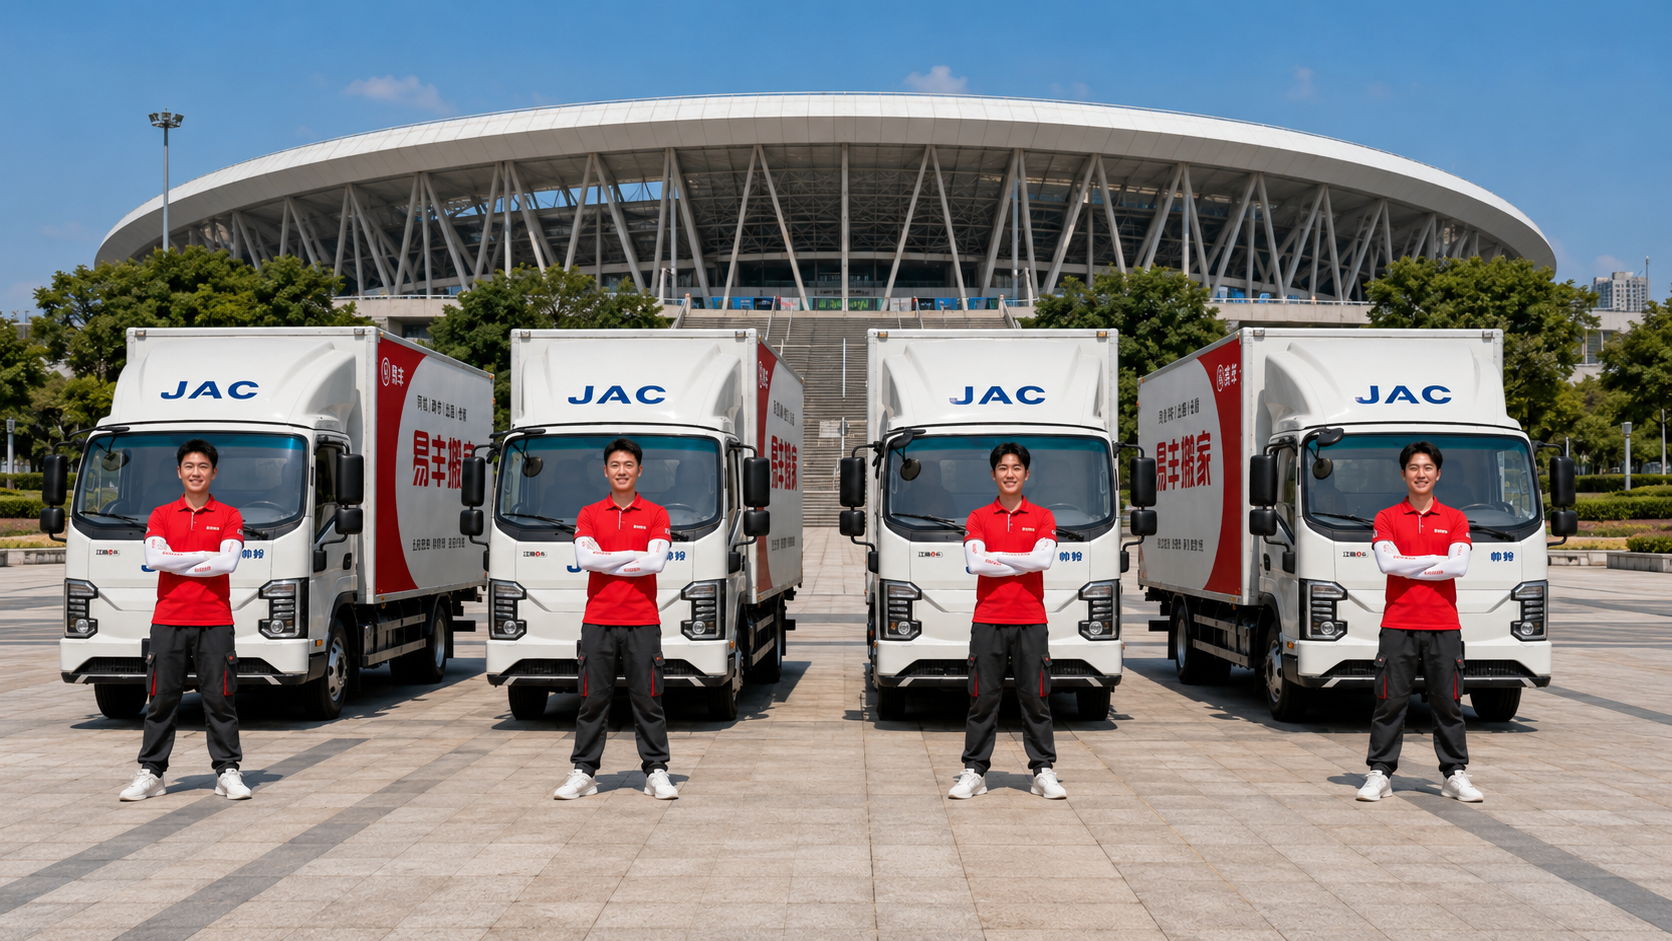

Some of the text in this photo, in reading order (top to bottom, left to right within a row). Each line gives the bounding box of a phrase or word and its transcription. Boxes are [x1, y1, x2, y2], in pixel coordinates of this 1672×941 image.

[160, 380, 259, 400] JAC
[567, 385, 667, 405] JAC
[949, 385, 1046, 405] JAC
[1355, 385, 1452, 405] JAC
[1156, 430, 1211, 491] 易丰搬家
